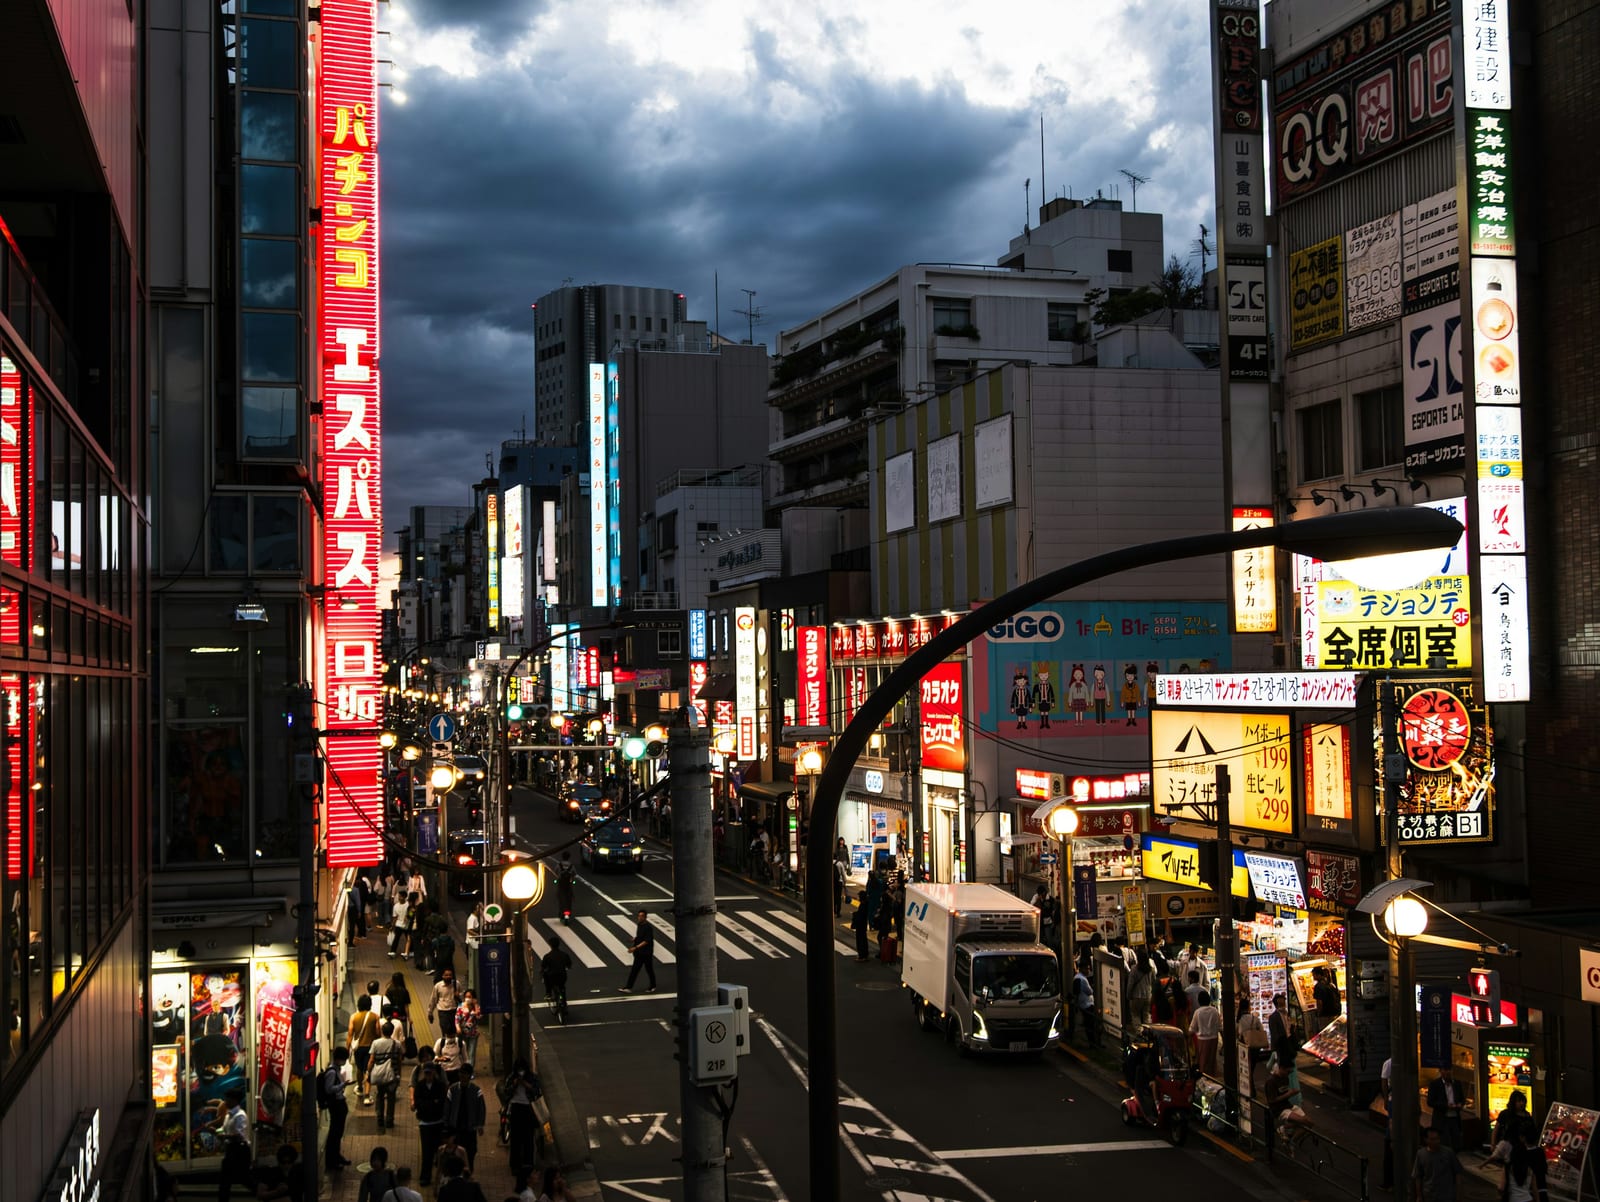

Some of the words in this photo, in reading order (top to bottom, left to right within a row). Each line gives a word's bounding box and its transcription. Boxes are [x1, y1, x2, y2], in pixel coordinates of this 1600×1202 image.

[1222, 15, 1257, 38] QQ
[1491, 92, 1505, 104] 6F
[1237, 113, 1250, 124] 6F
[1282, 93, 1348, 183] QQ
[333, 102, 369, 288] パチンコ
[1419, 273, 1449, 297] ESPORTS
[1239, 343, 1268, 360] 4F
[1412, 407, 1448, 430] ESPORTS
[333, 327, 373, 589] エスパス
[1406, 444, 1466, 468] eスポーツカフェ
[1493, 465, 1507, 475] 2F
[1243, 551, 1256, 607] ライザカ
[1076, 620, 1091, 636] 1F
[1122, 618, 1149, 636] B1F
[1154, 616, 1177, 625] SEPU
[1303, 585, 1315, 668] エレベーター有
[1453, 612, 1469, 624] 3F
[1154, 626, 1177, 635] RISH
[805, 629, 818, 679] カラオケ
[1323, 624, 1459, 668] 全席個室
[922, 679, 960, 704] カラオケ
[1497, 682, 1516, 700] B1
[1246, 773, 1286, 795] 生ビール
[1325, 746, 1333, 810] ミライザカ
[1169, 777, 1216, 804] ミライザ
[1459, 815, 1480, 834] B1
[1161, 850, 1200, 880] マツモト
[271, 1020, 288, 1076] はじめて
[707, 1060, 726, 1072] 21P
